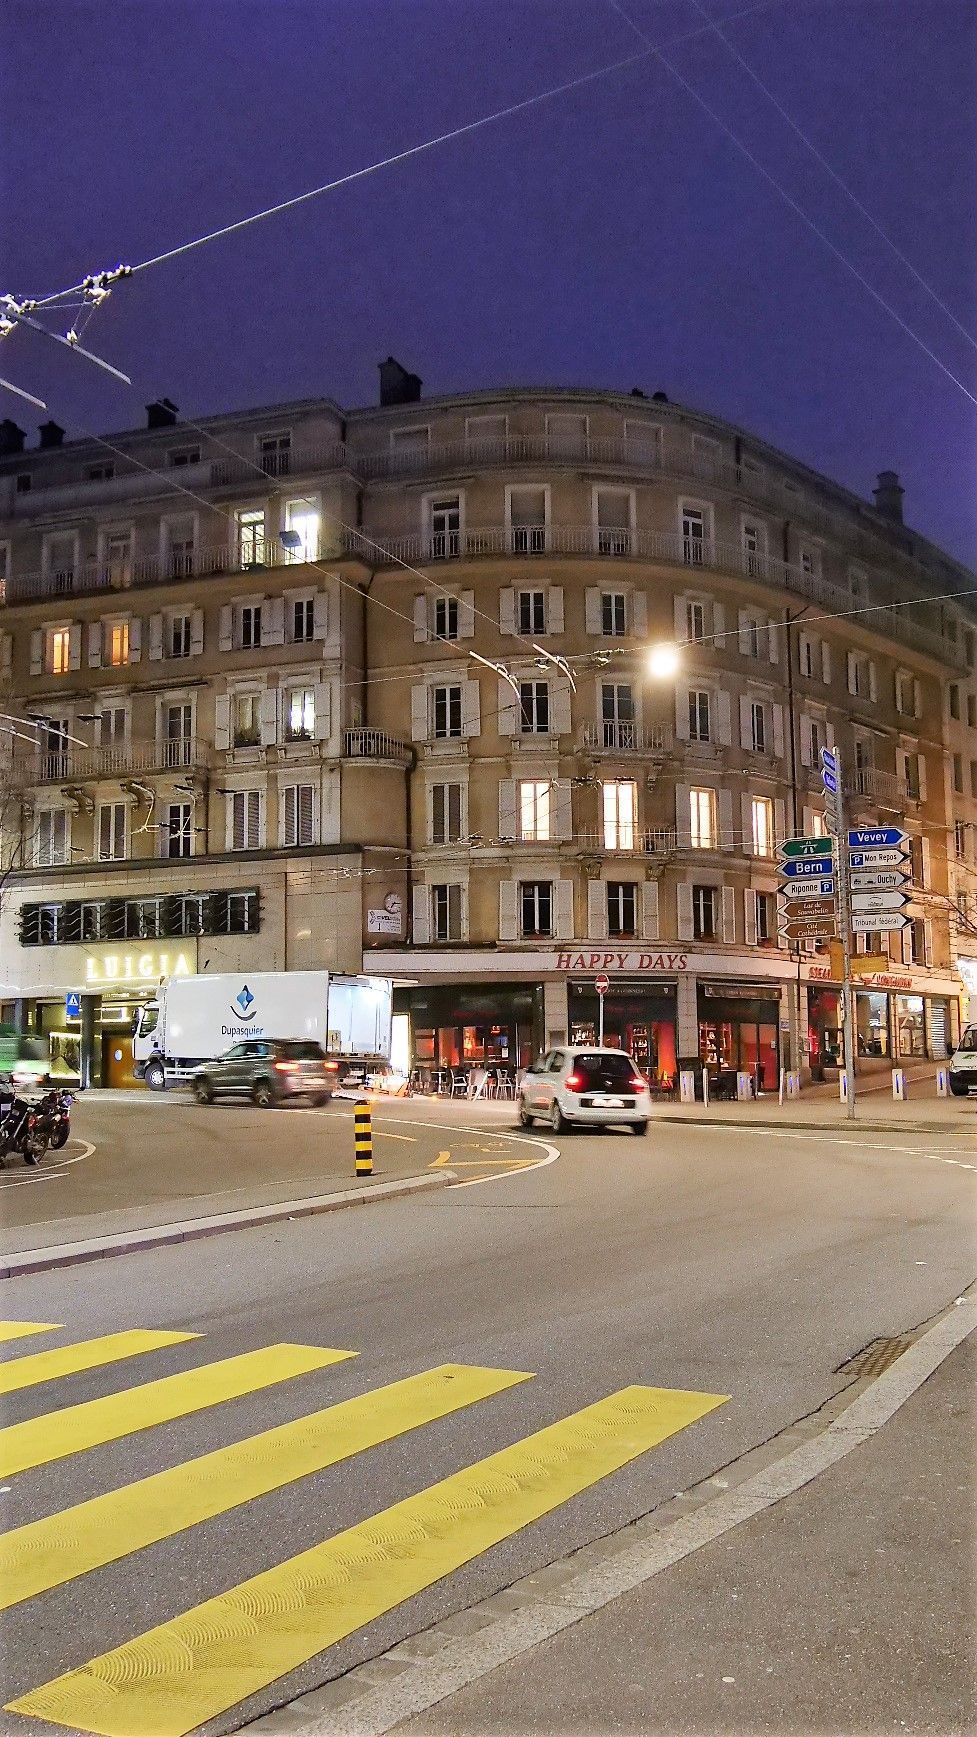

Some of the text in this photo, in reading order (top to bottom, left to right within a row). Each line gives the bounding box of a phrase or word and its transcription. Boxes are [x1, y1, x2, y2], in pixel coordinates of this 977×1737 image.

[857, 833, 888, 842] Vevey
[864, 854, 877, 862] Mon
[879, 853, 897, 862] Repos
[796, 862, 823, 873] Bern
[877, 874, 897, 885] Ouchy
[791, 884, 818, 893] Riponne
[86, 953, 190, 979] LUIGIA
[555, 953, 688, 970] HAPPY DAYS
[221, 1025, 264, 1037] Dupasquier
